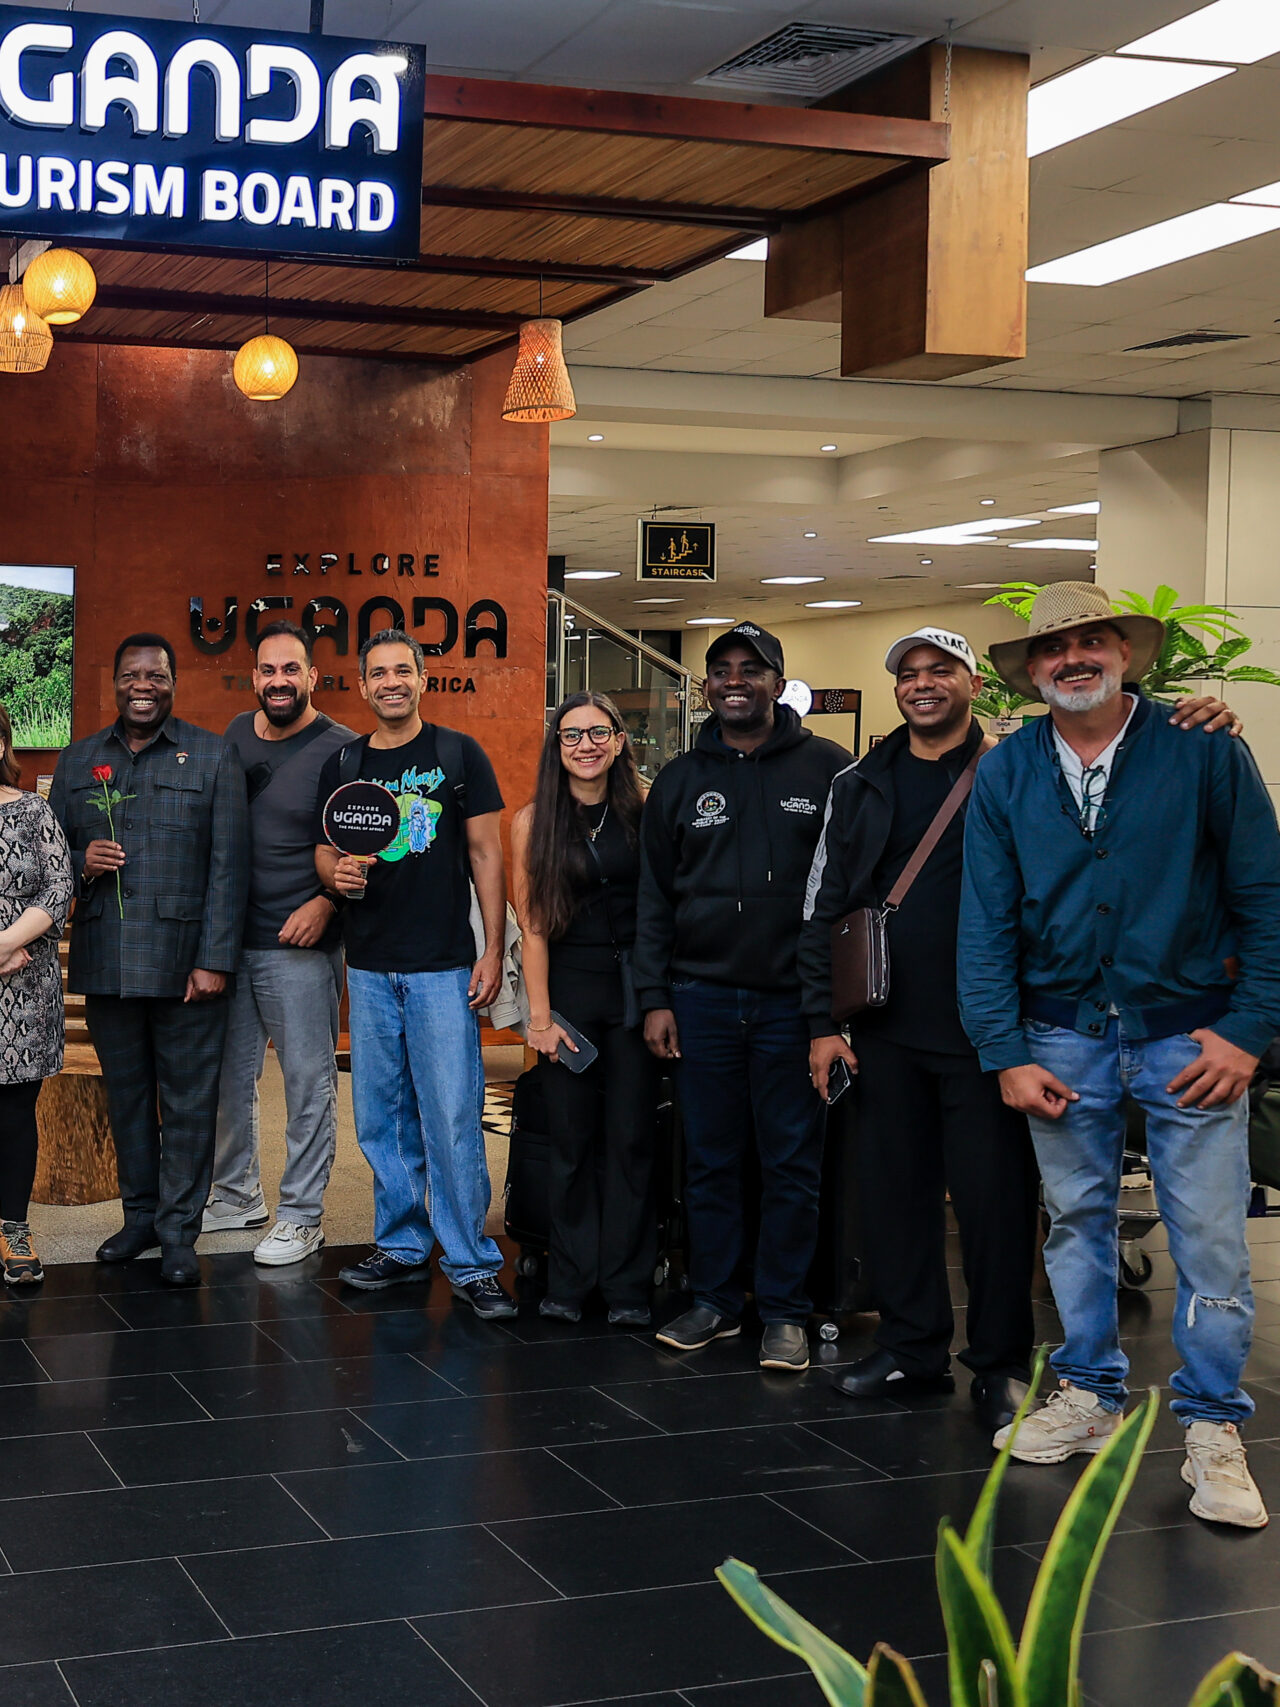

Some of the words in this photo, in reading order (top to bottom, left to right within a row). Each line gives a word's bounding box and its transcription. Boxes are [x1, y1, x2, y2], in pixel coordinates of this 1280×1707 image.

[201, 168, 397, 233] BOARD
[266, 552, 441, 577] EXPLORE
[651, 567, 704, 577] STAIRCASE
[426, 676, 477, 693] RICA
[347, 804, 380, 812] EXPLORE
[780, 799, 817, 811] UGANDA
[333, 810, 392, 827] UGANDA
